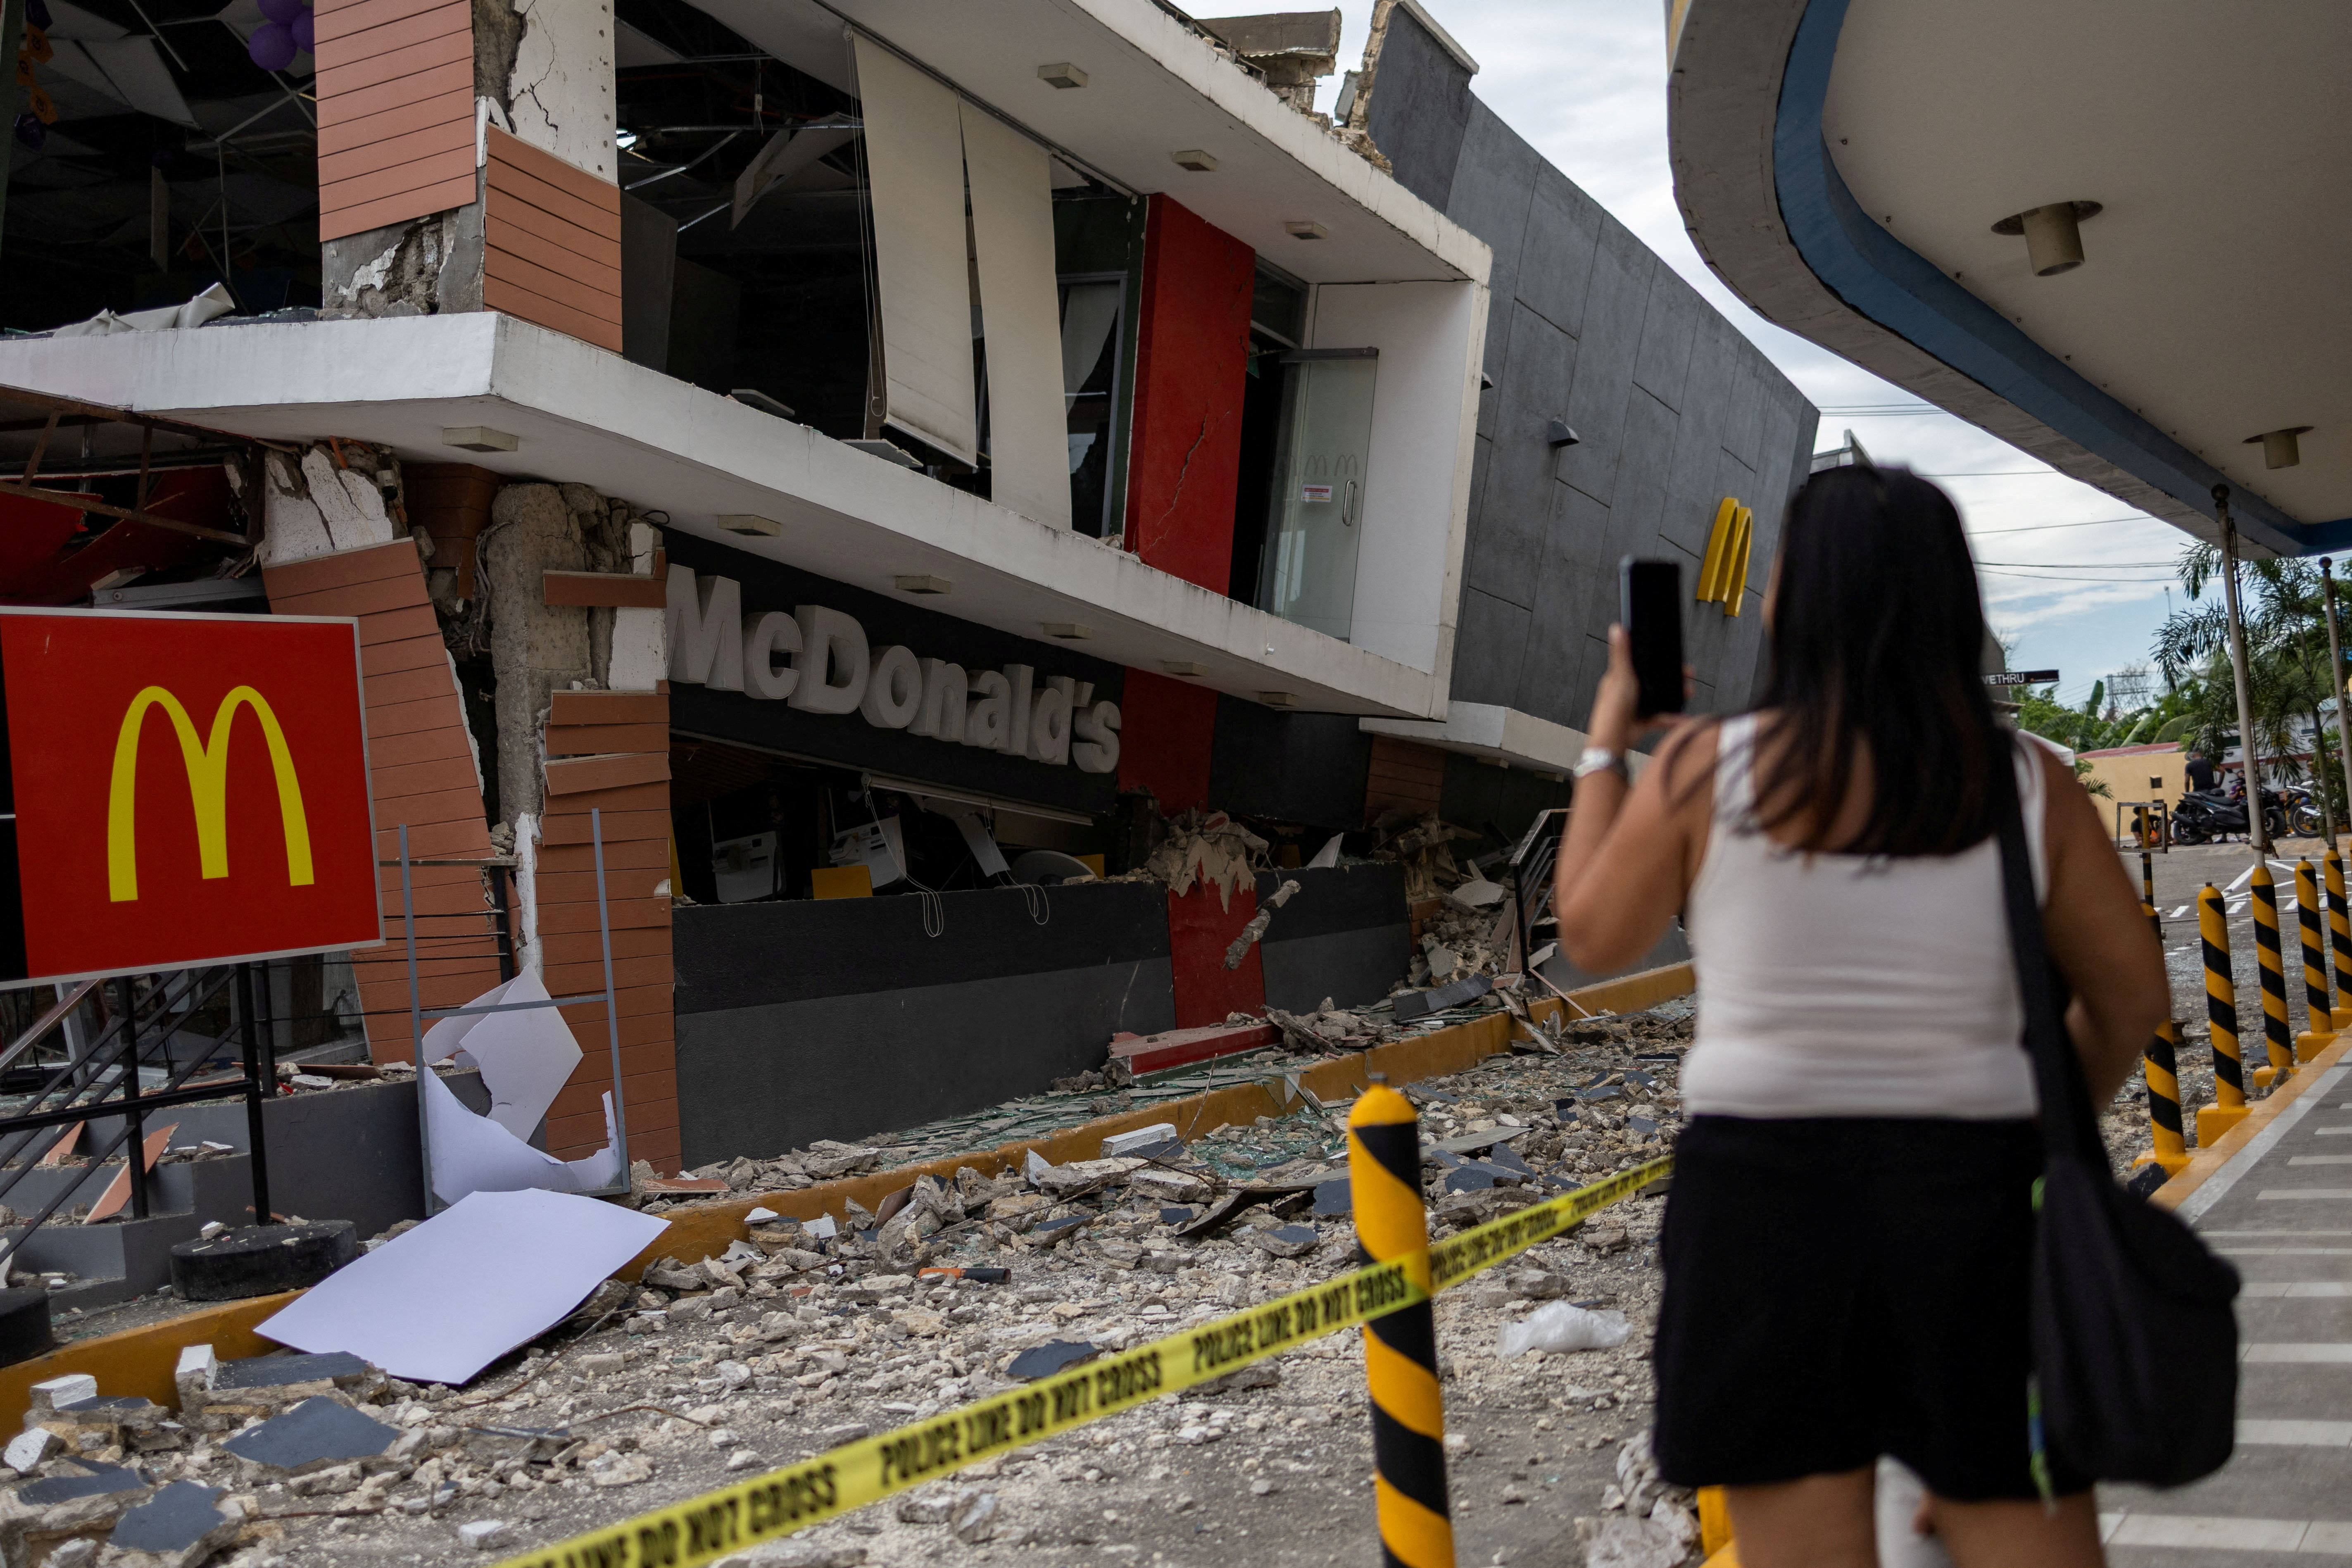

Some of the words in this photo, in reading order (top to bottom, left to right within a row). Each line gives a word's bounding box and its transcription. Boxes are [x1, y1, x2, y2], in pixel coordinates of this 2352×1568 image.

[664, 563, 1122, 773] McDonald's
[1193, 1318, 1253, 1373] POLICE
[1256, 1306, 1291, 1348] LINE
[1295, 1297, 1317, 1335] DO
[1322, 1285, 1351, 1323] NOT
[1356, 1265, 1405, 1313] CROSS
[881, 1420, 960, 1486] POLICE
[966, 1403, 1011, 1454] LINE
[1017, 1391, 1046, 1435] DO
[1049, 1375, 1089, 1424] NOT
[1096, 1351, 1161, 1407] CROSS
[638, 1518, 678, 1568] DO
[685, 1498, 738, 1556] NOT
[749, 1464, 838, 1533] CROSS
